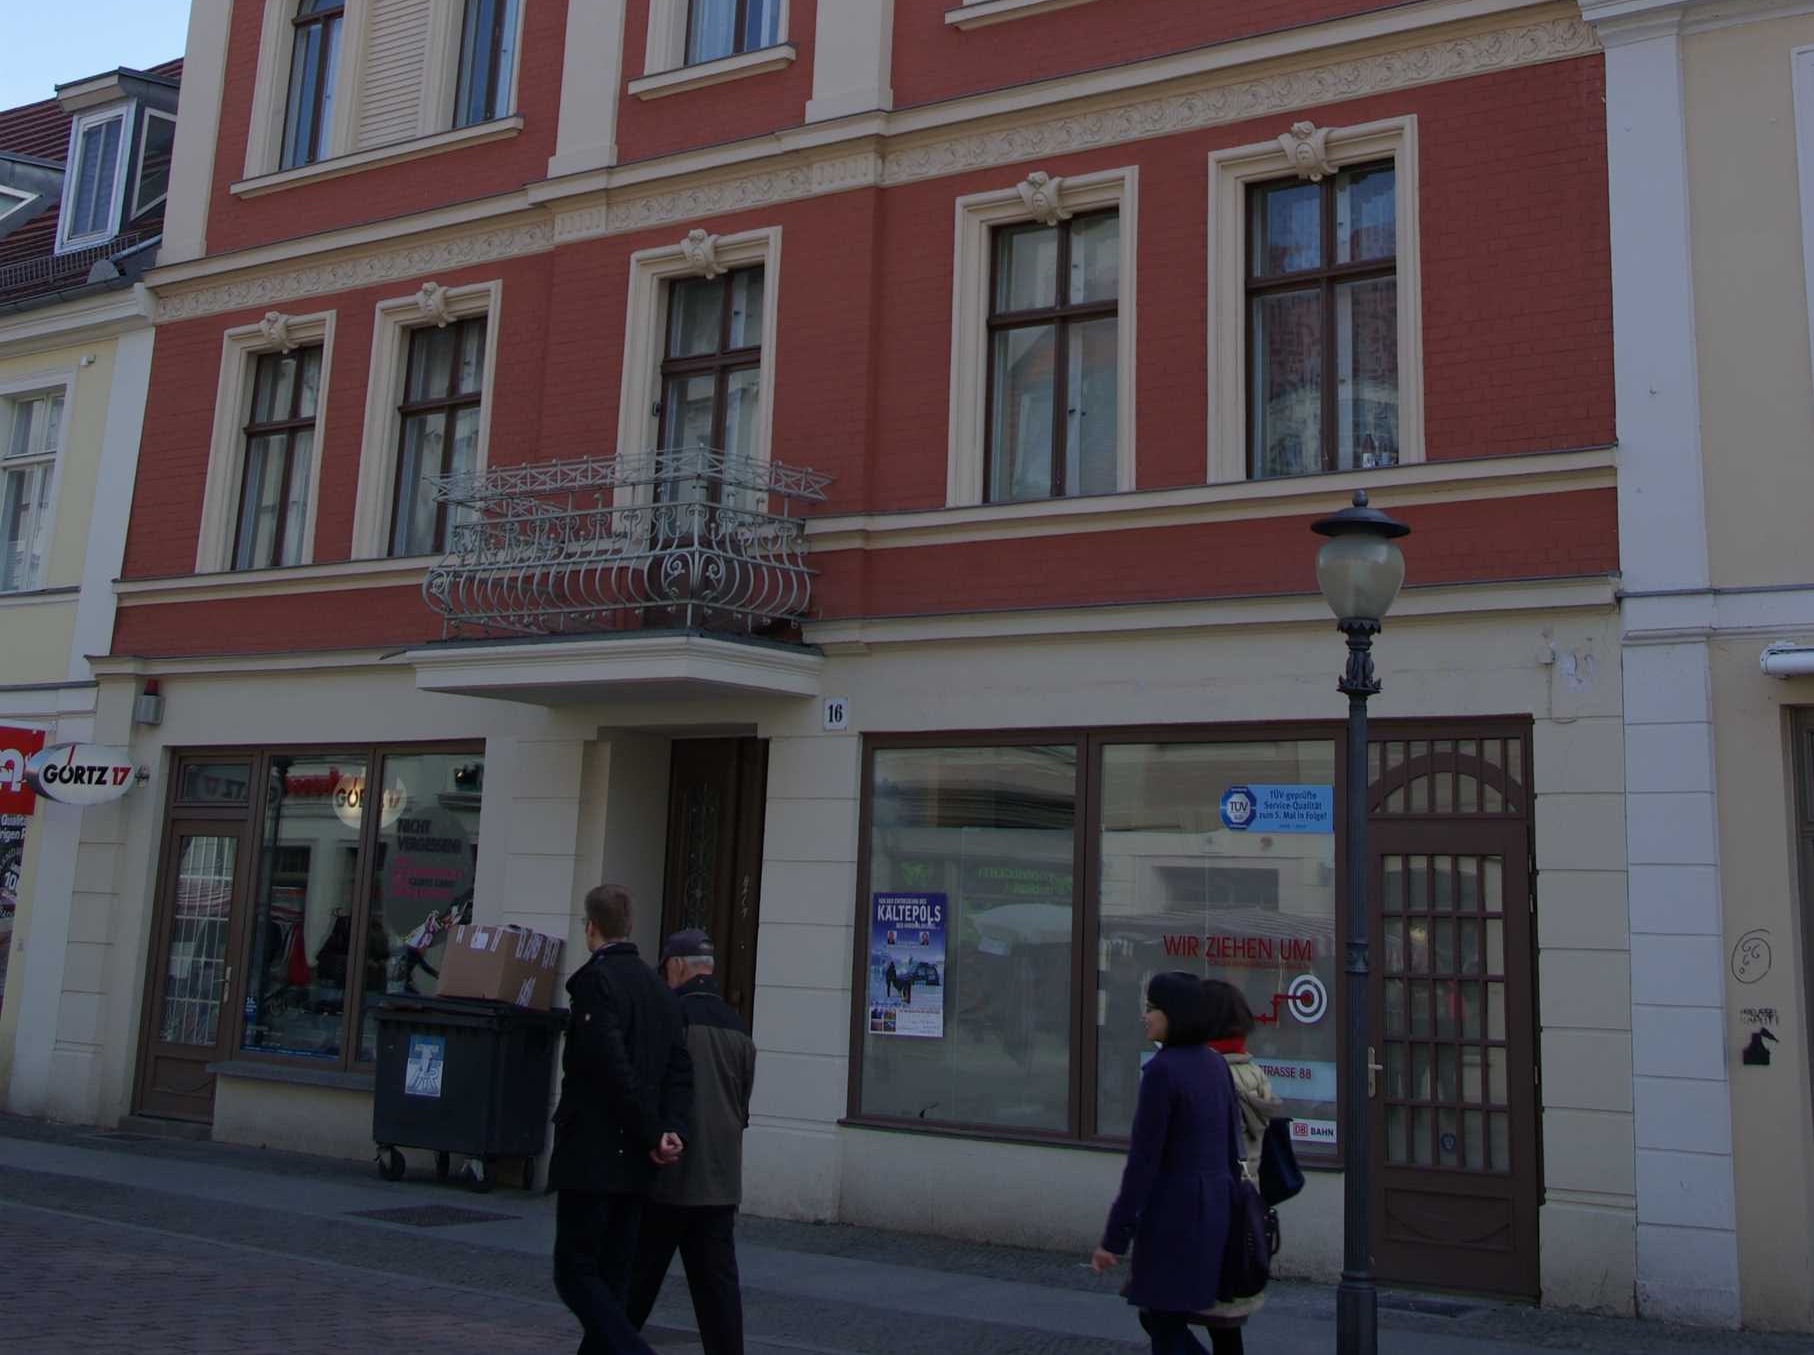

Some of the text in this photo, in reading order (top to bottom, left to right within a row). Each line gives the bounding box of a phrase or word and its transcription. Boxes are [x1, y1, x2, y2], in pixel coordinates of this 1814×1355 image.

[828, 704, 843, 723] 16
[112, 767, 132, 785] 17
[1163, 935, 1312, 961] WIR ZIEHEN UM
[1299, 1067, 1312, 1079] 88
[1310, 1127, 1335, 1137] BAHN
